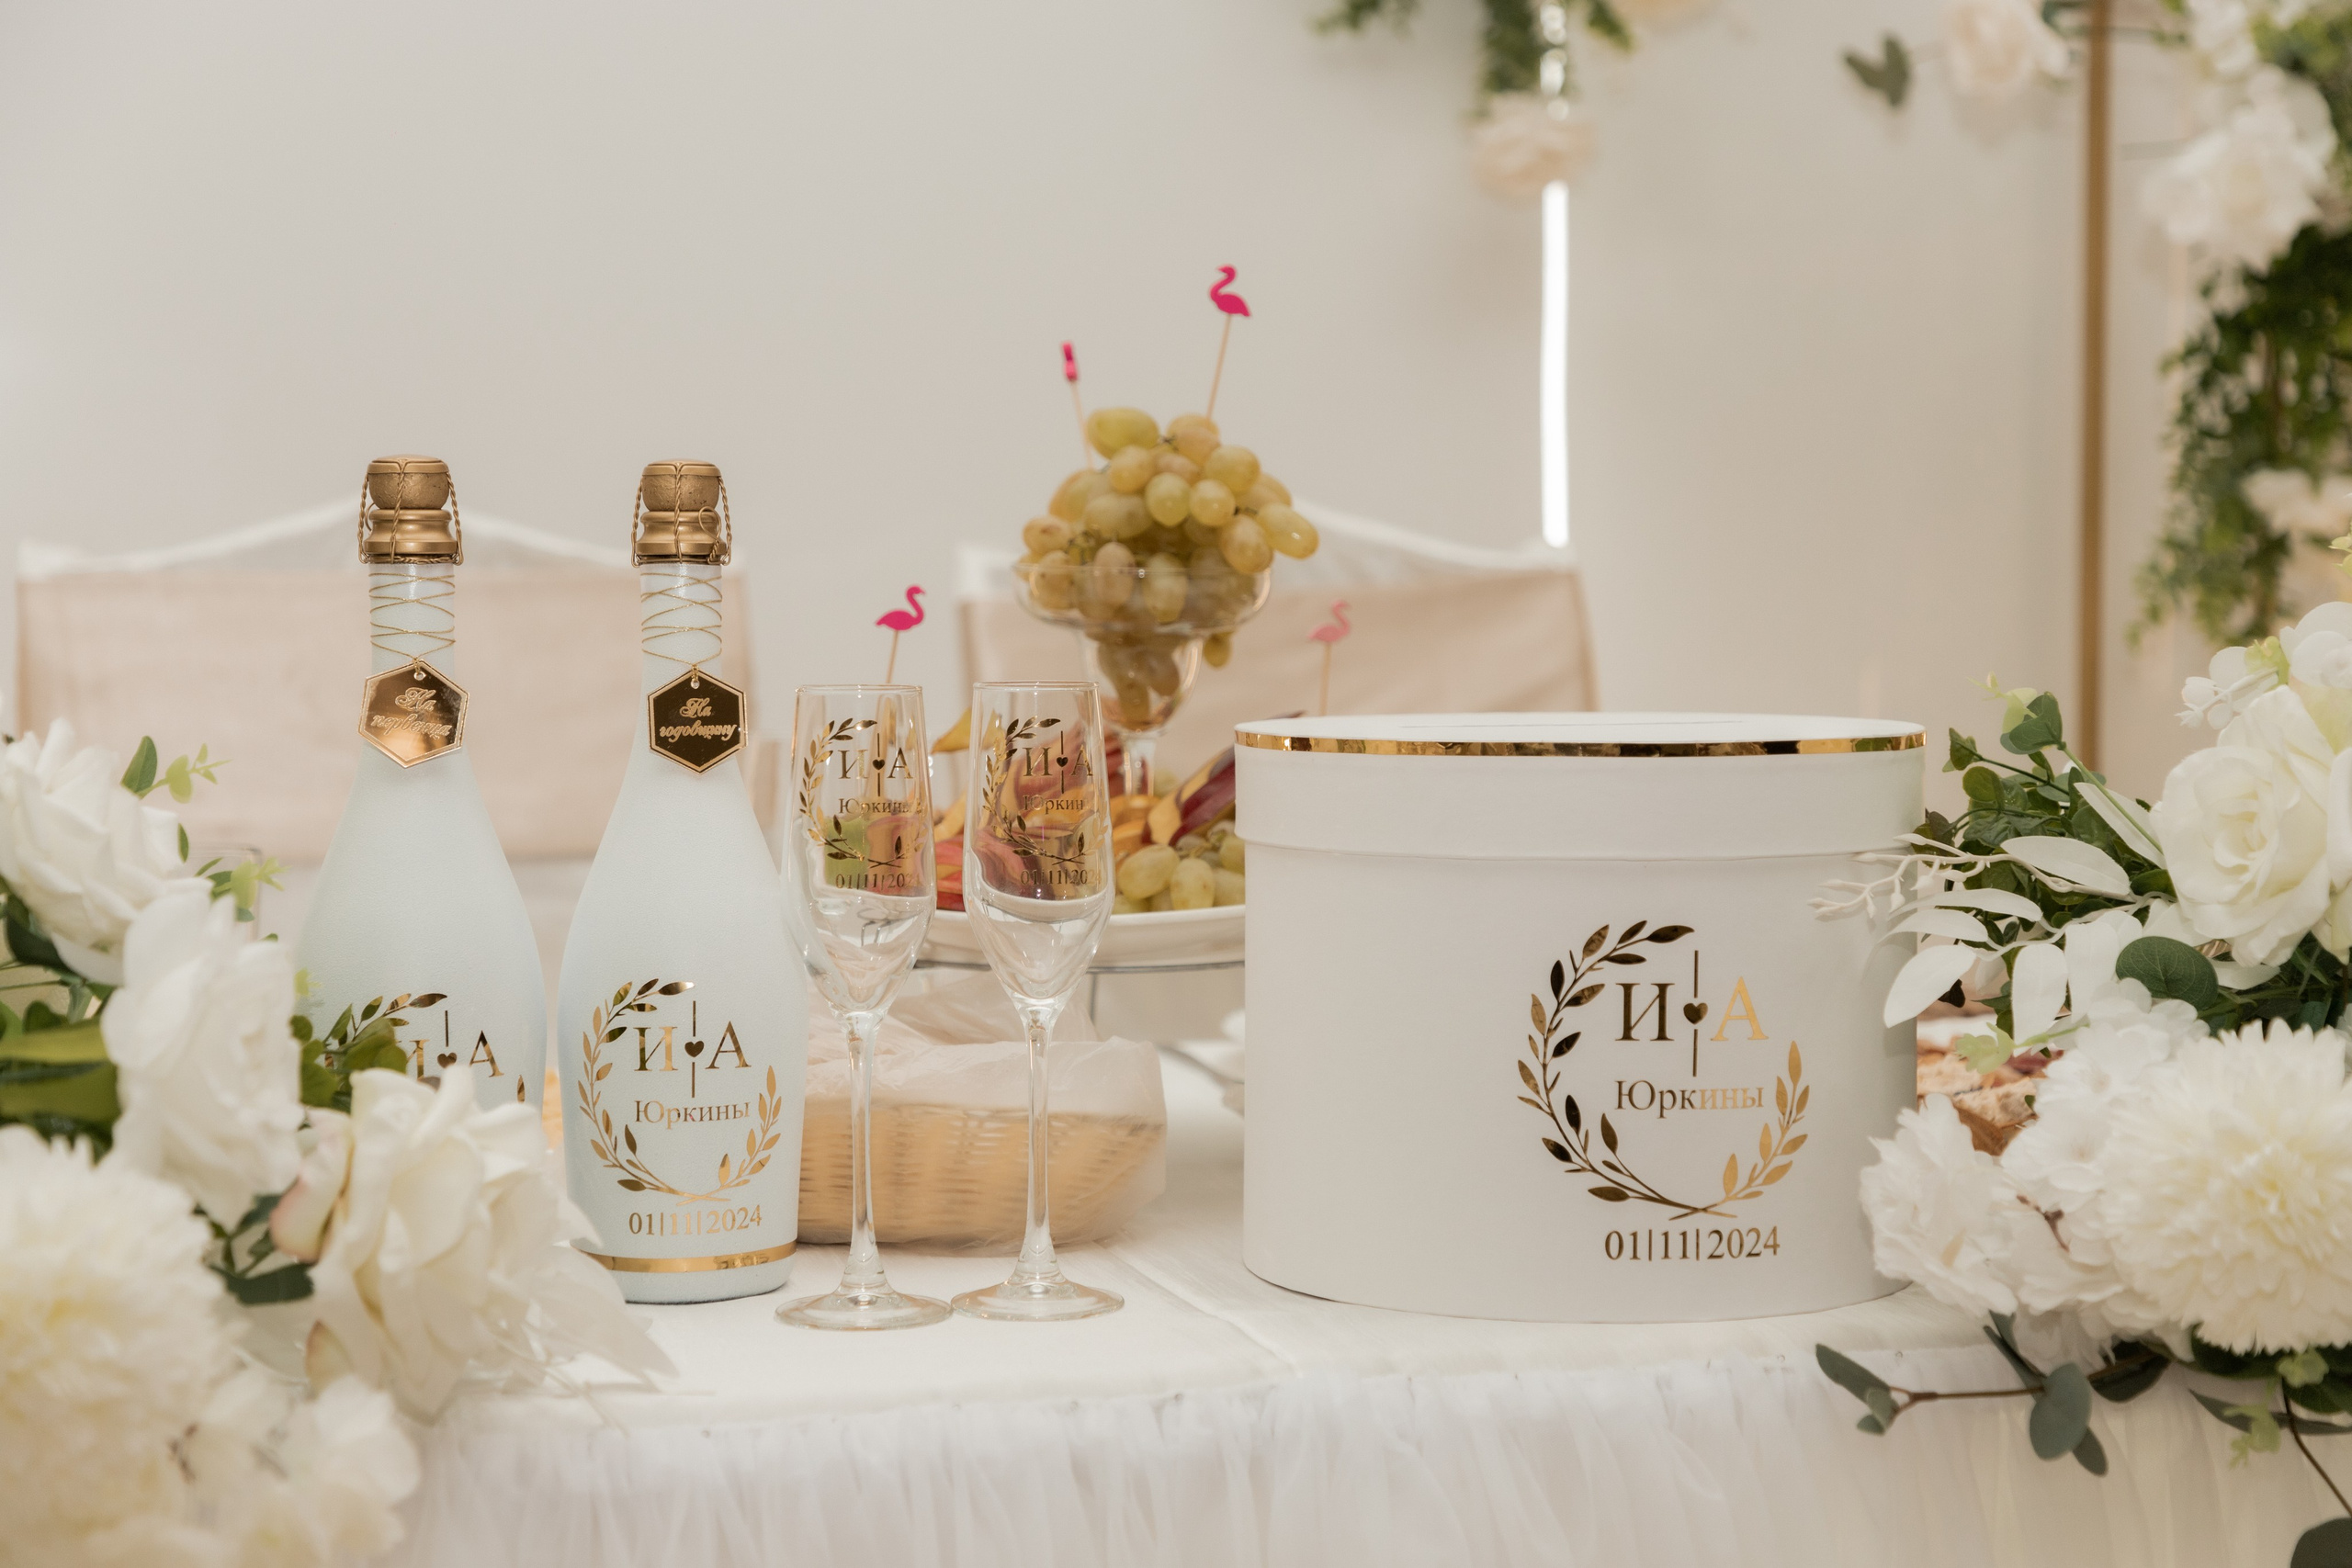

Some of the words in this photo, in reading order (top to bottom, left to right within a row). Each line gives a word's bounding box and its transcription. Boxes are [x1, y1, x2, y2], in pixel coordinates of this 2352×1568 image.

[395, 687, 436, 711] На
[680, 697, 712, 718] На
[370, 714, 452, 739] первенца
[660, 719, 738, 743] годовщину
[887, 747, 913, 779] А
[1071, 745, 1093, 776] А
[1614, 982, 1675, 1042] И
[1710, 976, 1769, 1042] А
[633, 1025, 678, 1072] И
[705, 1021, 752, 1069] А
[1614, 1079, 1765, 1119] Юркины
[634, 1100, 752, 1130] Юркины
